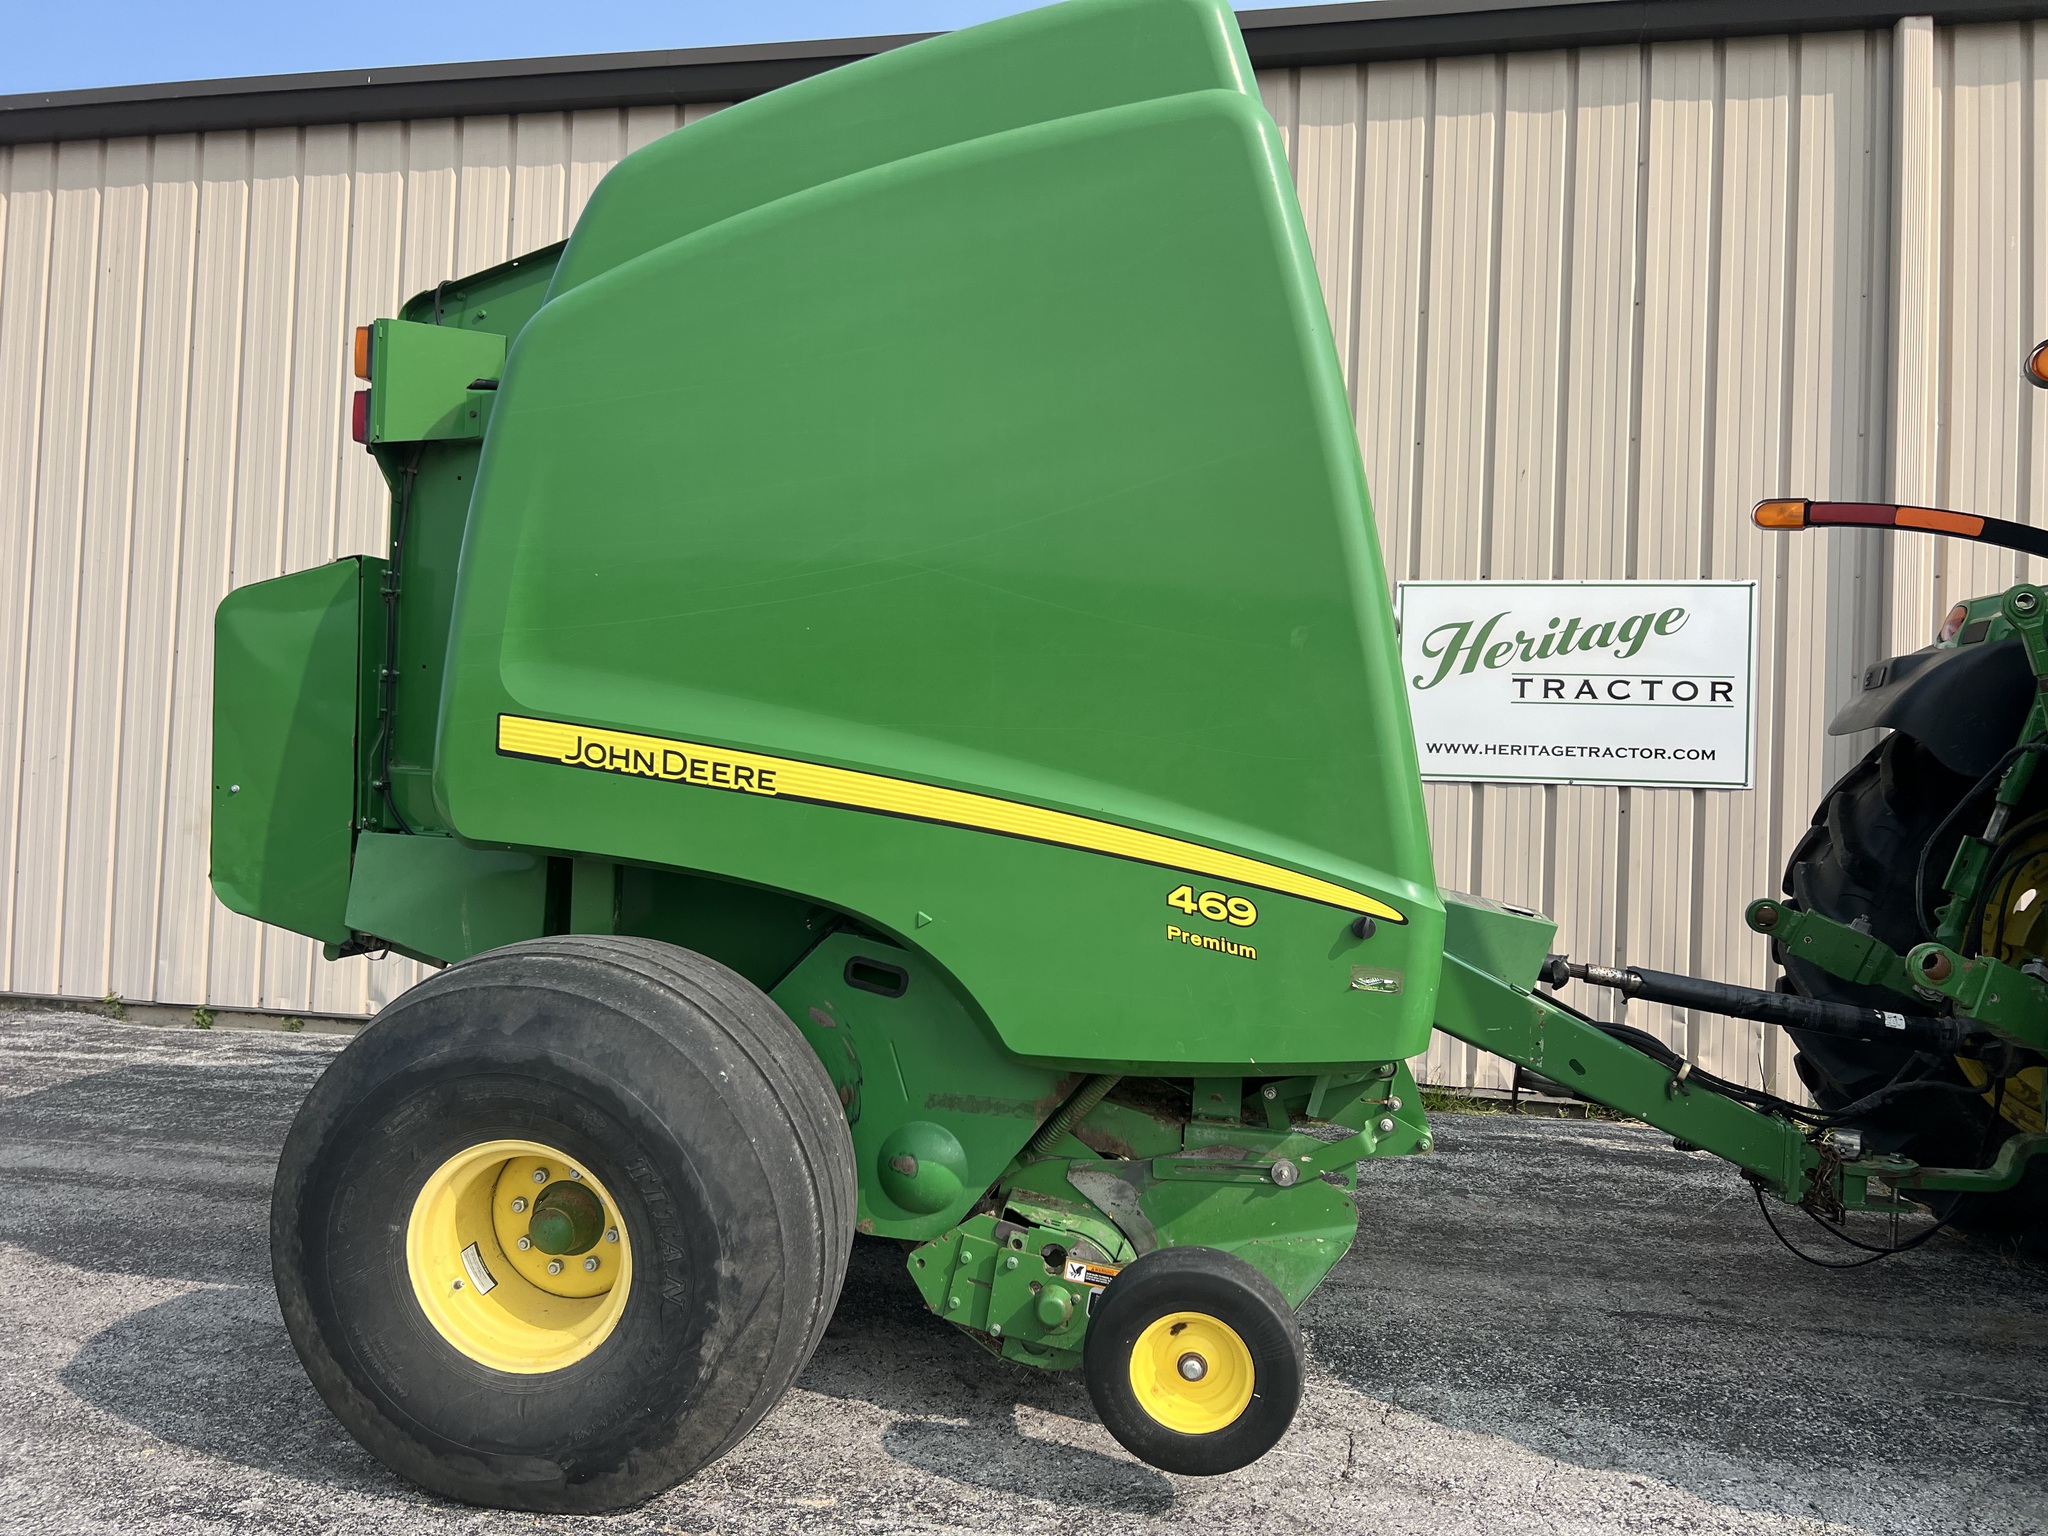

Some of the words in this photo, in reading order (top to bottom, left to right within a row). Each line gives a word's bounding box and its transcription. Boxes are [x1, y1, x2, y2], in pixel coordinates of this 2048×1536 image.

[1412, 607, 1691, 690] Heritage
[1511, 677, 1734, 703] TRACTOR
[564, 735, 655, 773] JOHN
[662, 749, 778, 792] DEERE
[1425, 742, 1717, 761] WWW.HERITAGETRACTOR.COM
[1166, 884, 1259, 928] 469
[1166, 924, 1258, 961] Premium
[624, 1155, 689, 1312] TITAN
